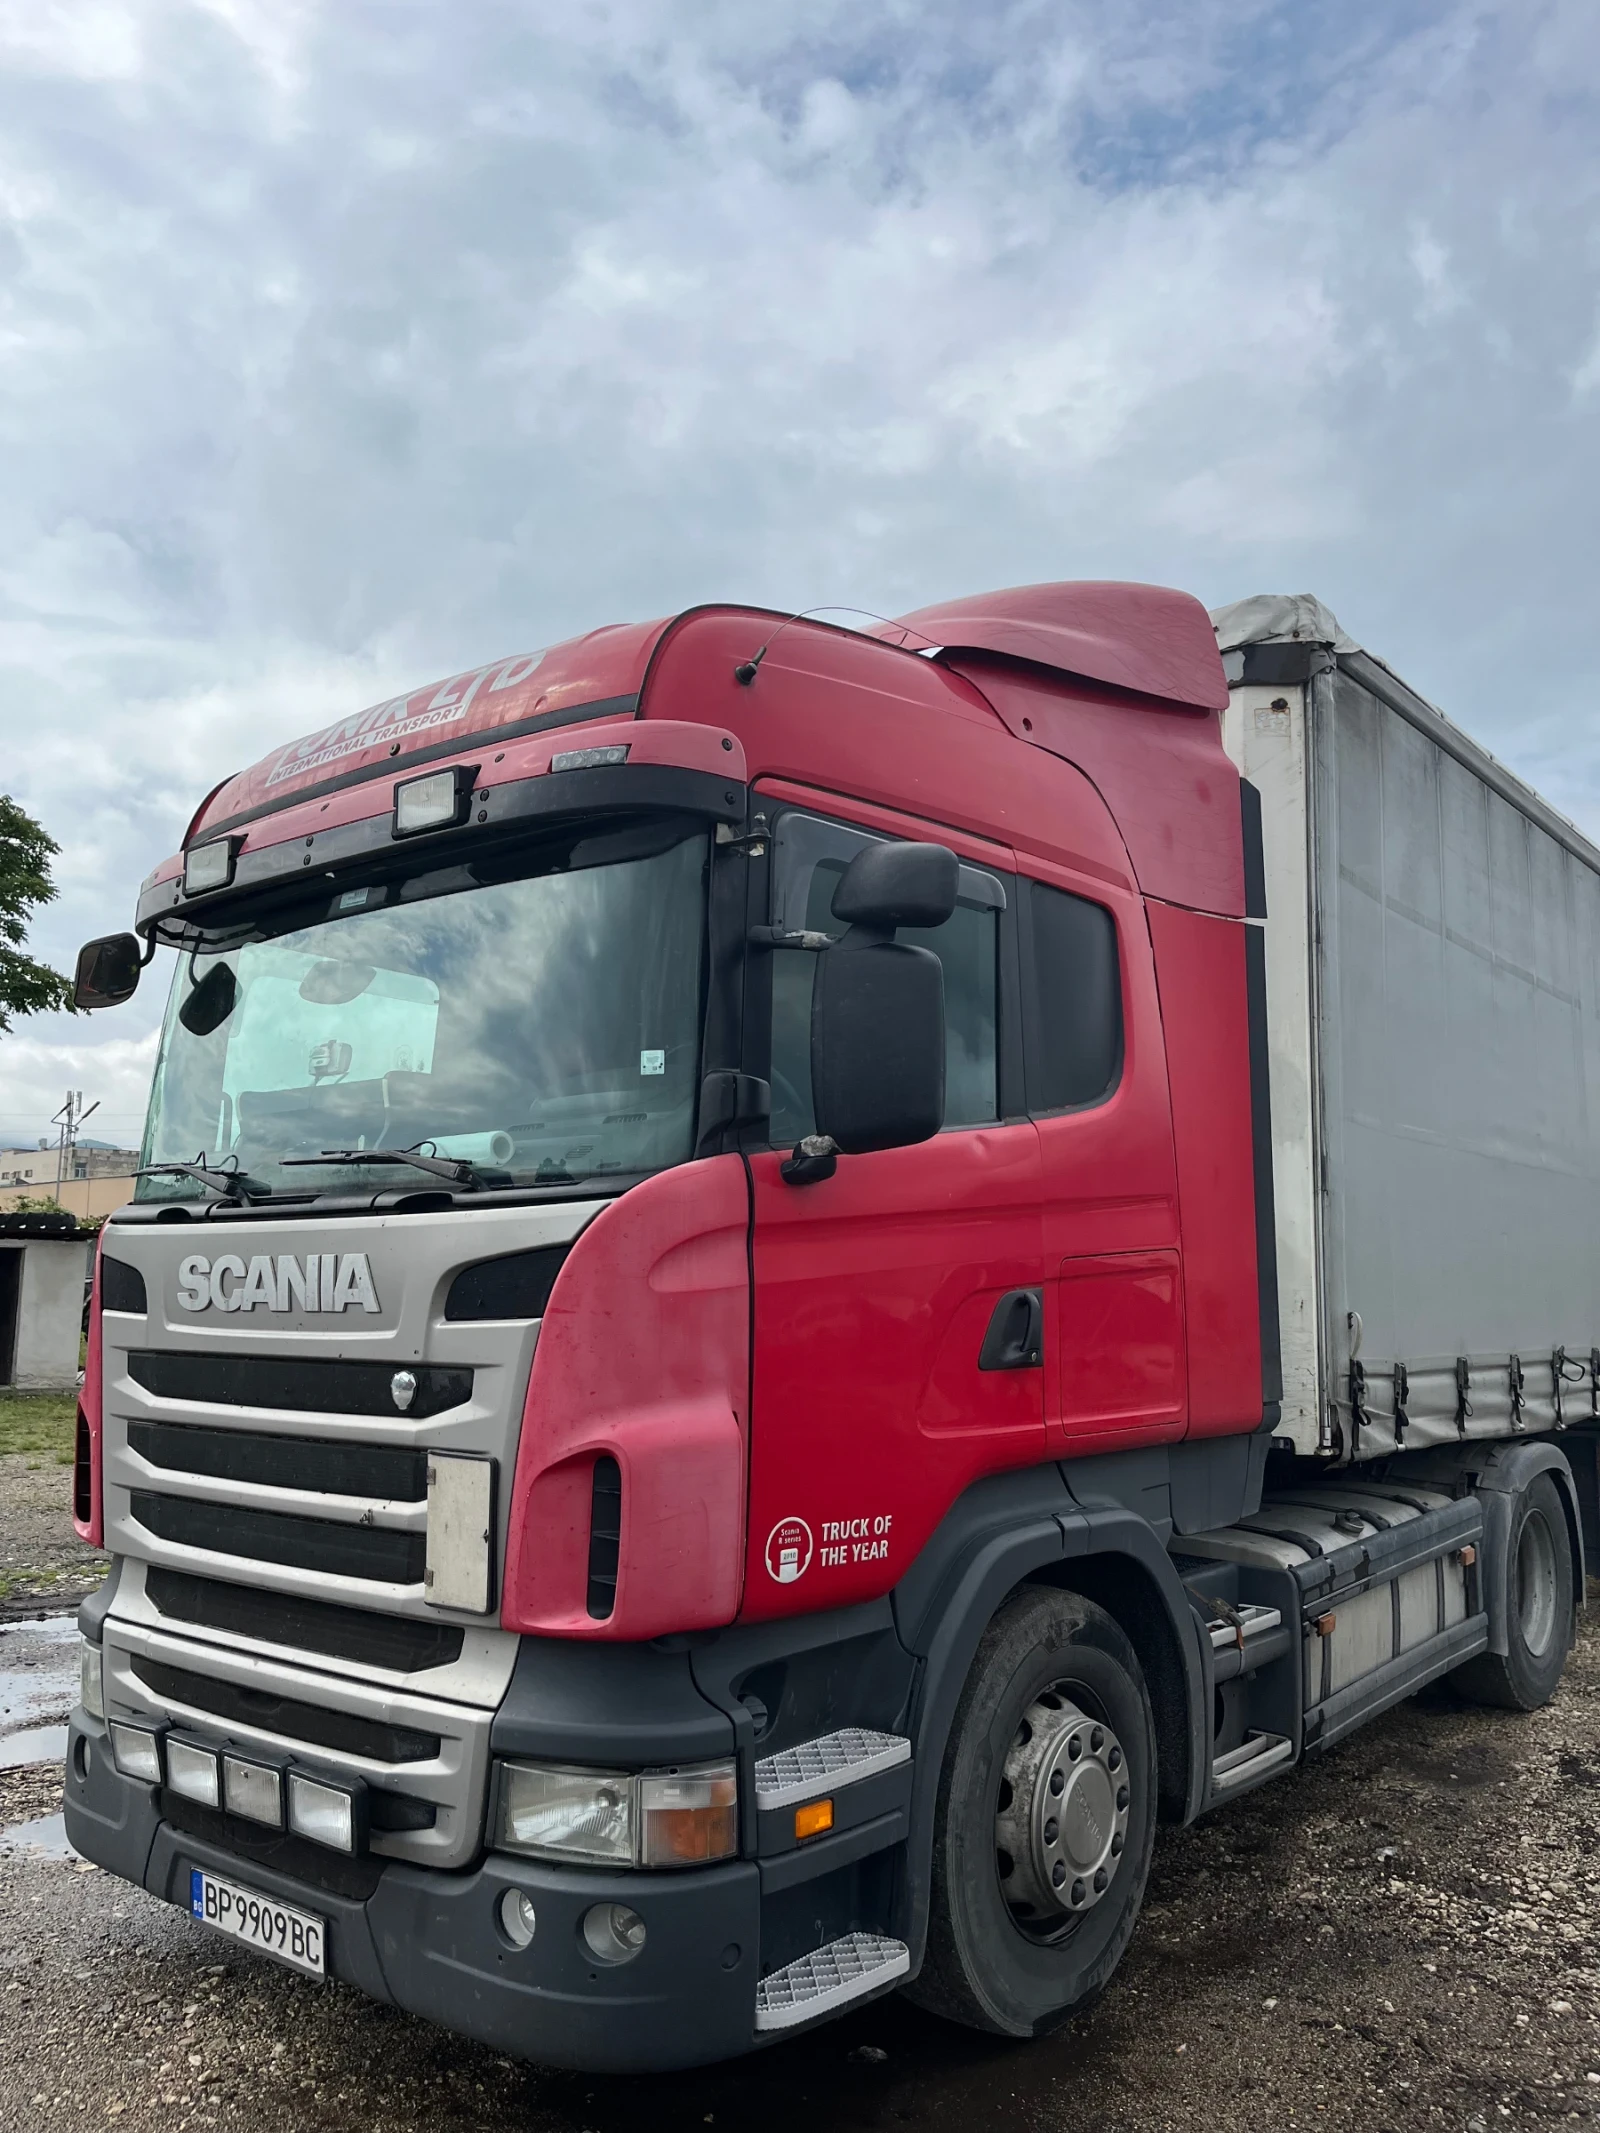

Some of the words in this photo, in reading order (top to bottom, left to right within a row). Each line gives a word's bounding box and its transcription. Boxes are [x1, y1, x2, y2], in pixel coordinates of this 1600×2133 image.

[427, 650, 546, 718] LTD
[269, 736, 367, 783] INTERNATIONAL
[373, 706, 462, 742] TRANSPORT
[177, 1253, 382, 1313] SCANIA
[780, 1528, 800, 1536] Scania
[784, 1536, 802, 1544] series
[822, 1518, 869, 1542] TRUCK
[874, 1515, 892, 1535] OF
[783, 1551, 797, 1560] 2010
[820, 1545, 848, 1567] THE
[852, 1540, 889, 1562] YEAR
[193, 1899, 203, 1913] BG
